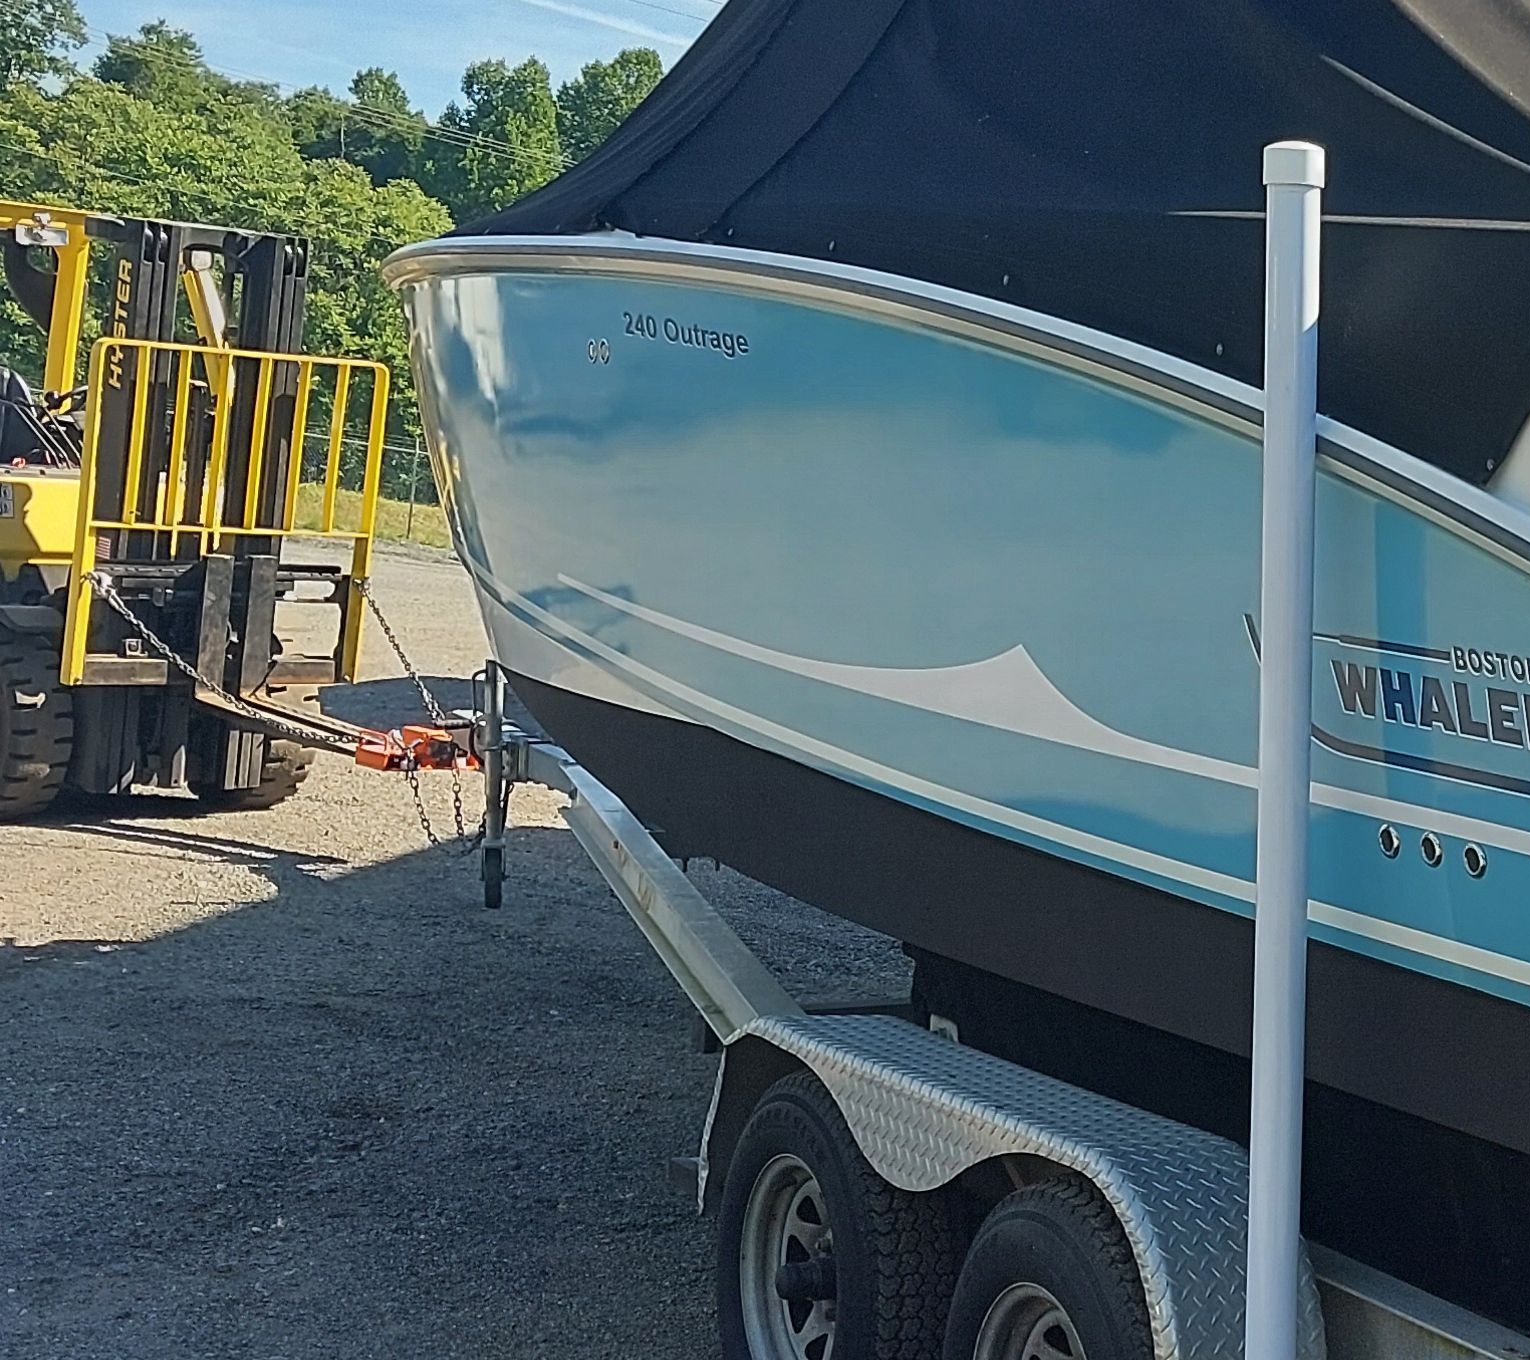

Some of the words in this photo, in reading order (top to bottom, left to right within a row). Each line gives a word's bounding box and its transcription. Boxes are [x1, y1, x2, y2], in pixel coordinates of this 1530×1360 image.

[108, 258, 133, 390] HYSTER
[622, 311, 657, 340] 240
[663, 318, 750, 359] Outrage
